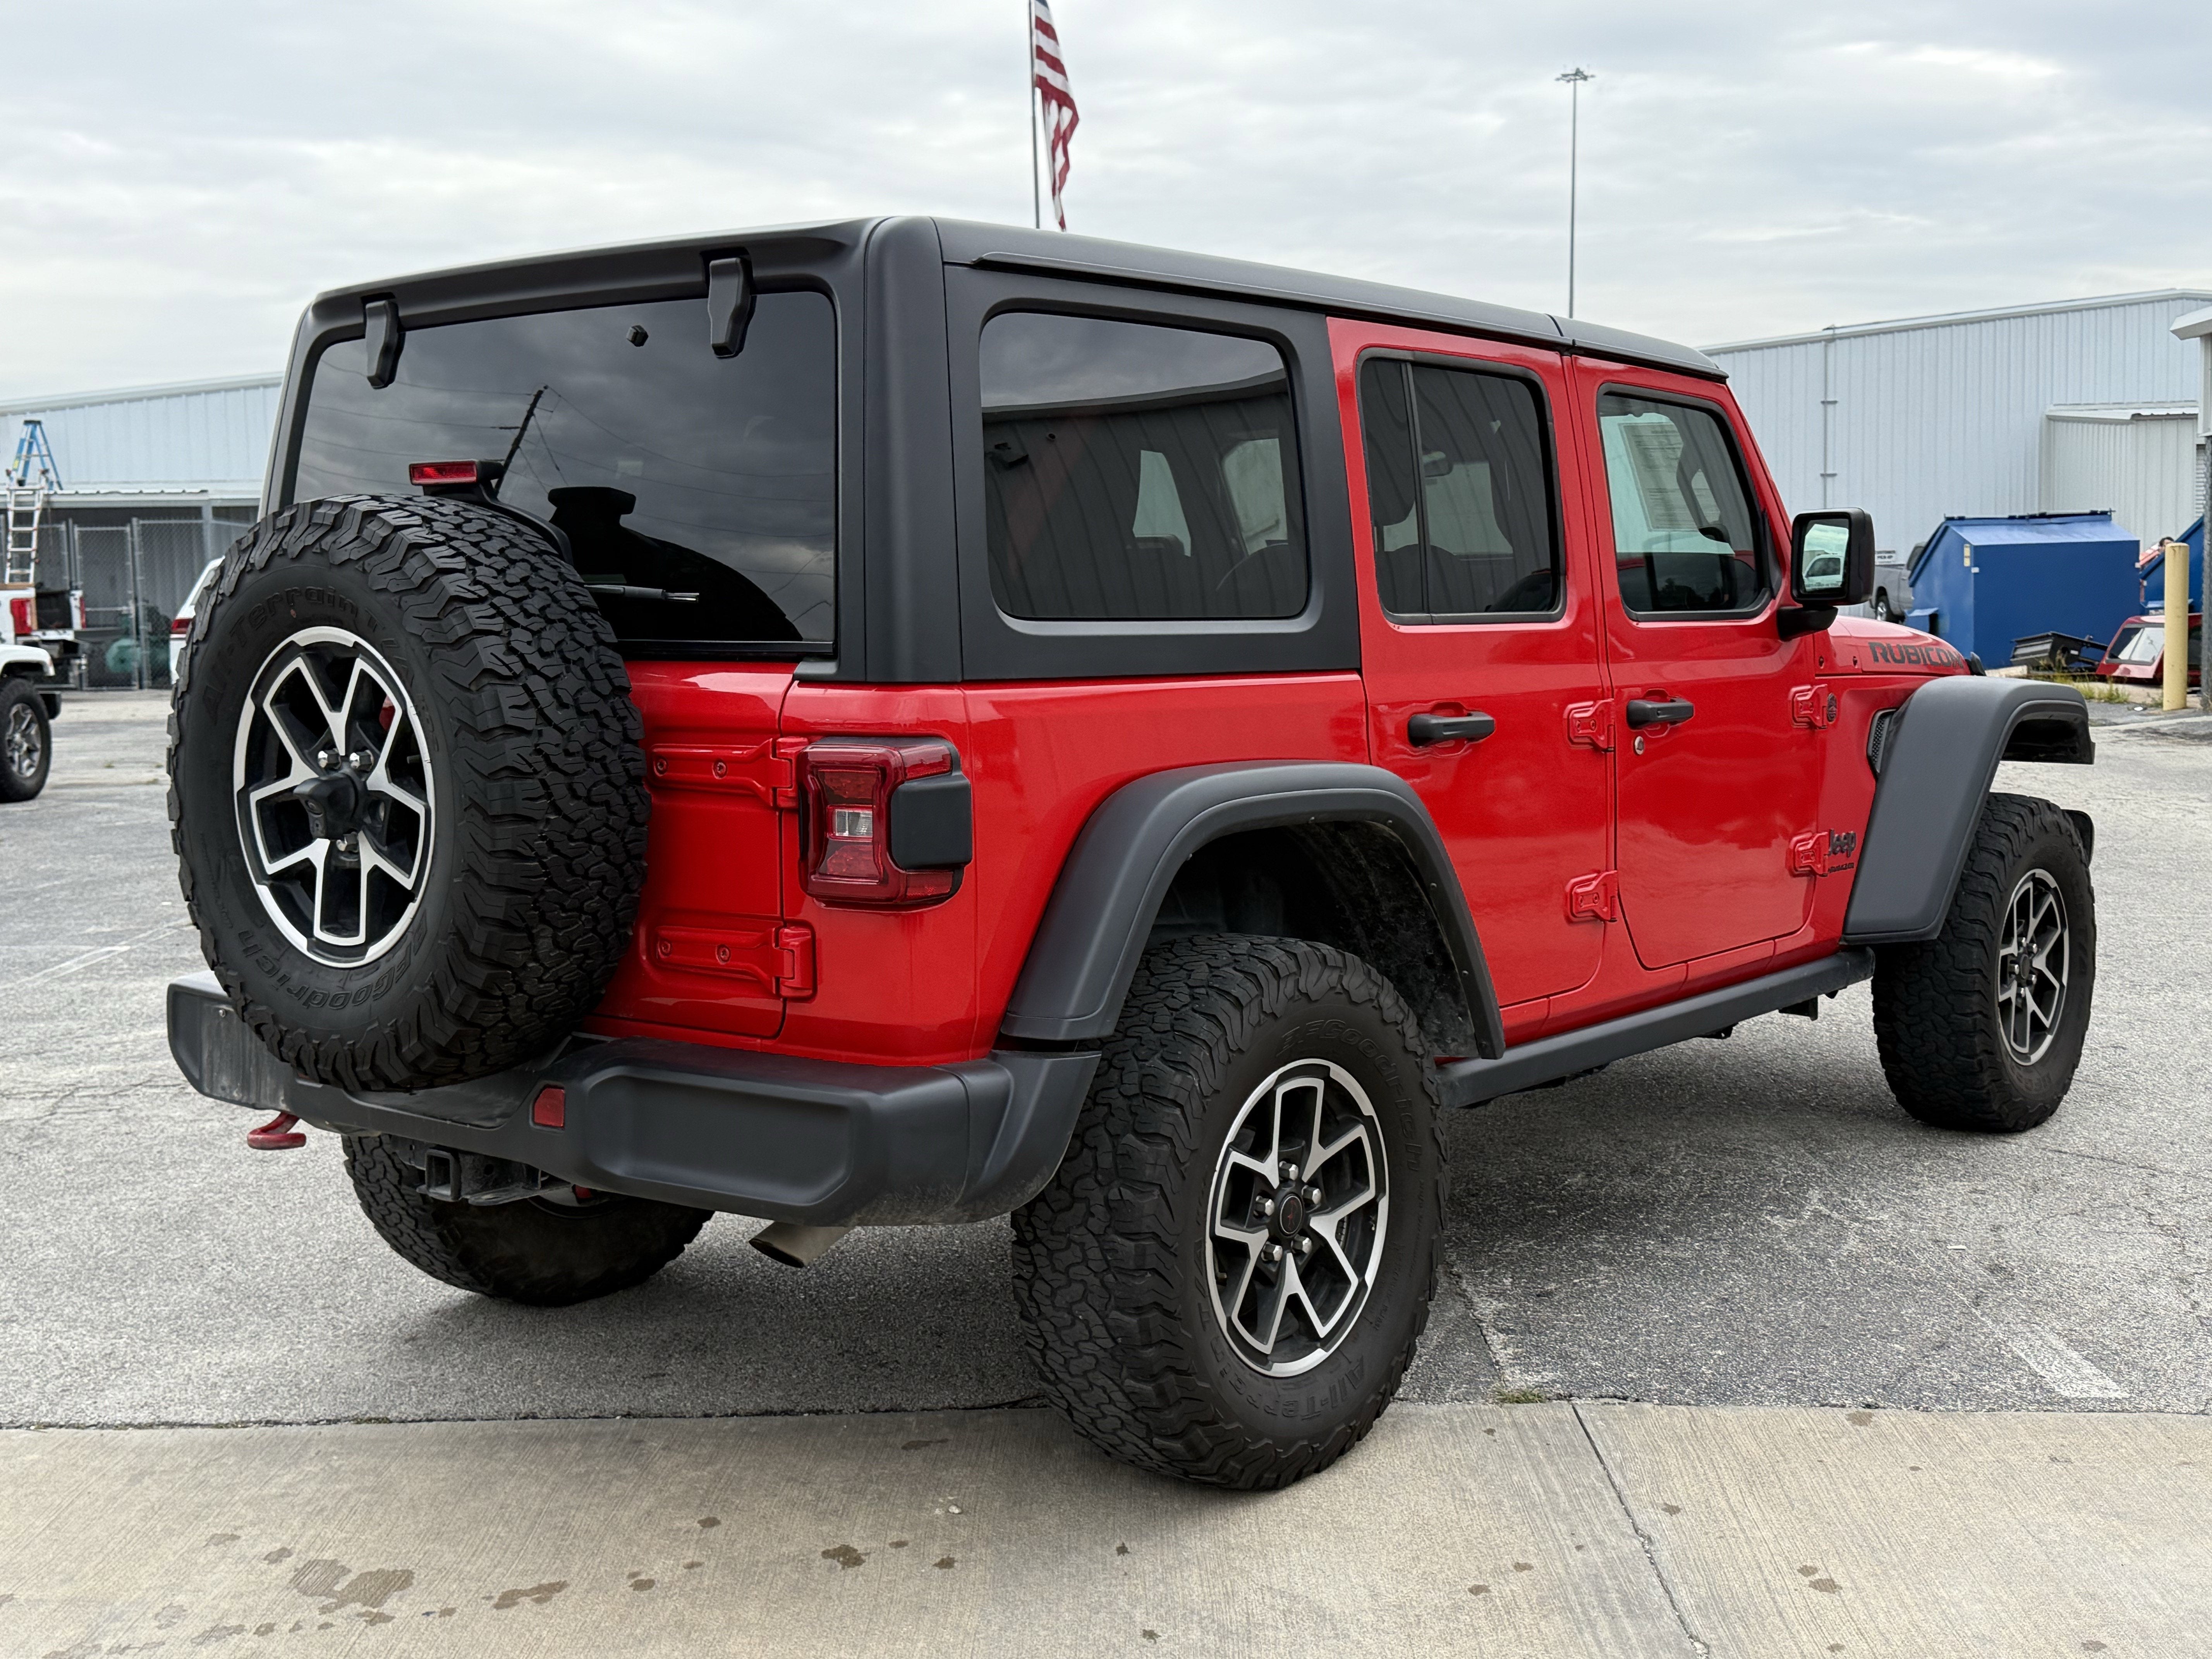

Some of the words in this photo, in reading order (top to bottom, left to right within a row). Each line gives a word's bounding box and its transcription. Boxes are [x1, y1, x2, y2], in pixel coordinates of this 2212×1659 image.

[1868, 641, 1964, 669] RUBICON
[1828, 828, 1856, 857] Jeep
[237, 910, 428, 1010] BFGoodrich
[1275, 1018, 1423, 1172] BFGoodrich
